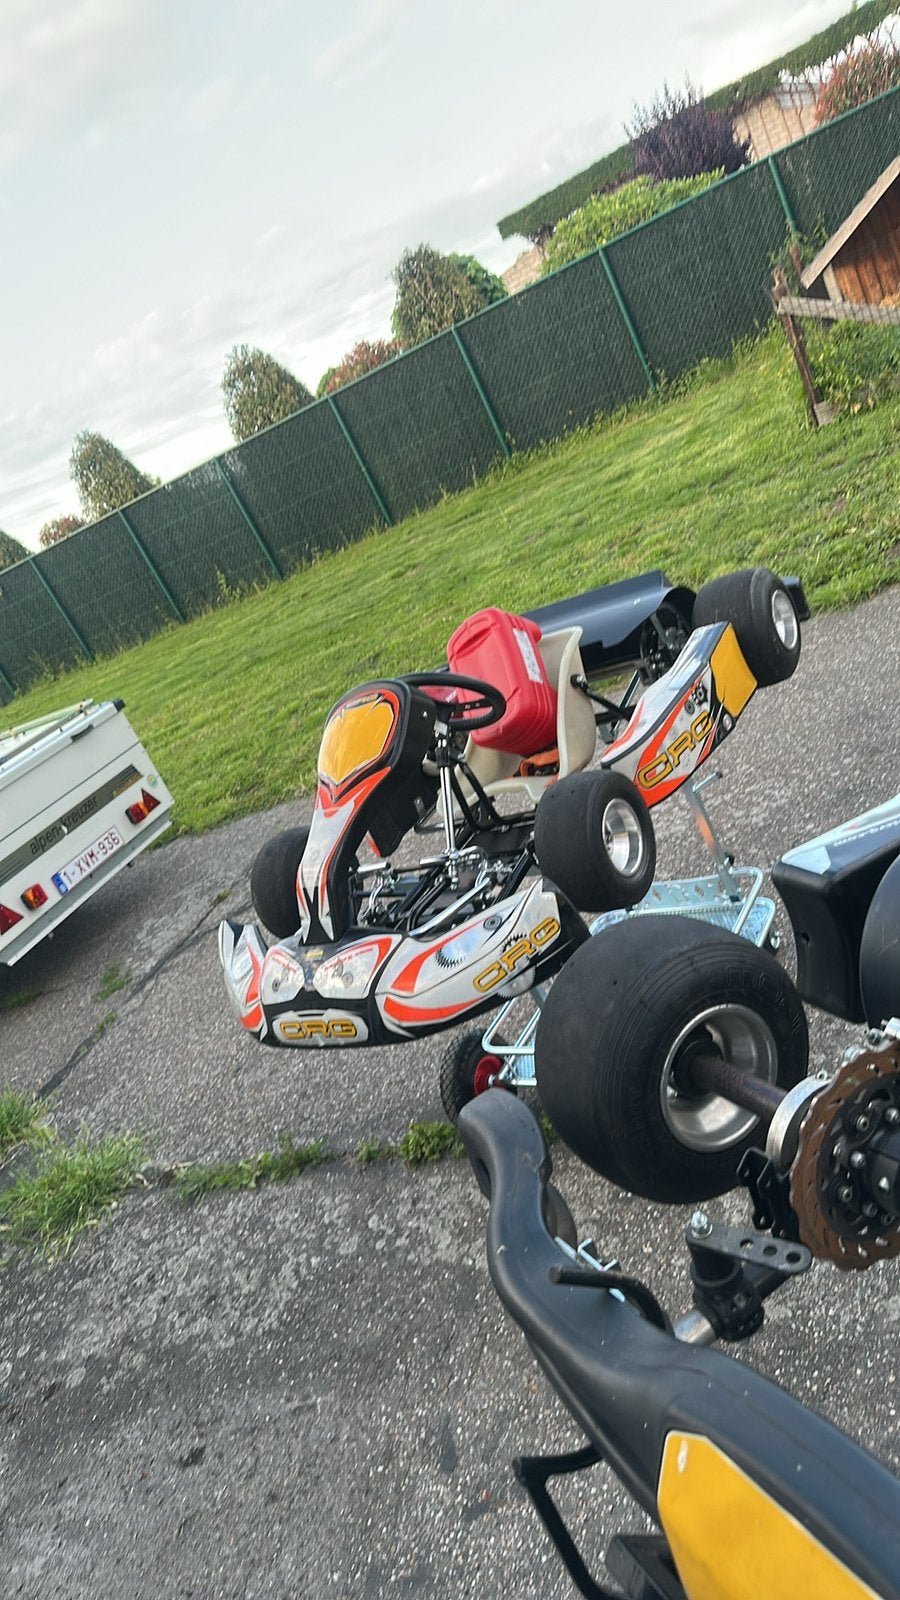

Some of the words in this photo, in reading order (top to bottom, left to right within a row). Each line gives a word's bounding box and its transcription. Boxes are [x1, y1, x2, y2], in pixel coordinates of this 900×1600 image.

[638, 710, 713, 789] CRG
[473, 916, 560, 993] CRG
[280, 1019, 358, 1040] CRG
